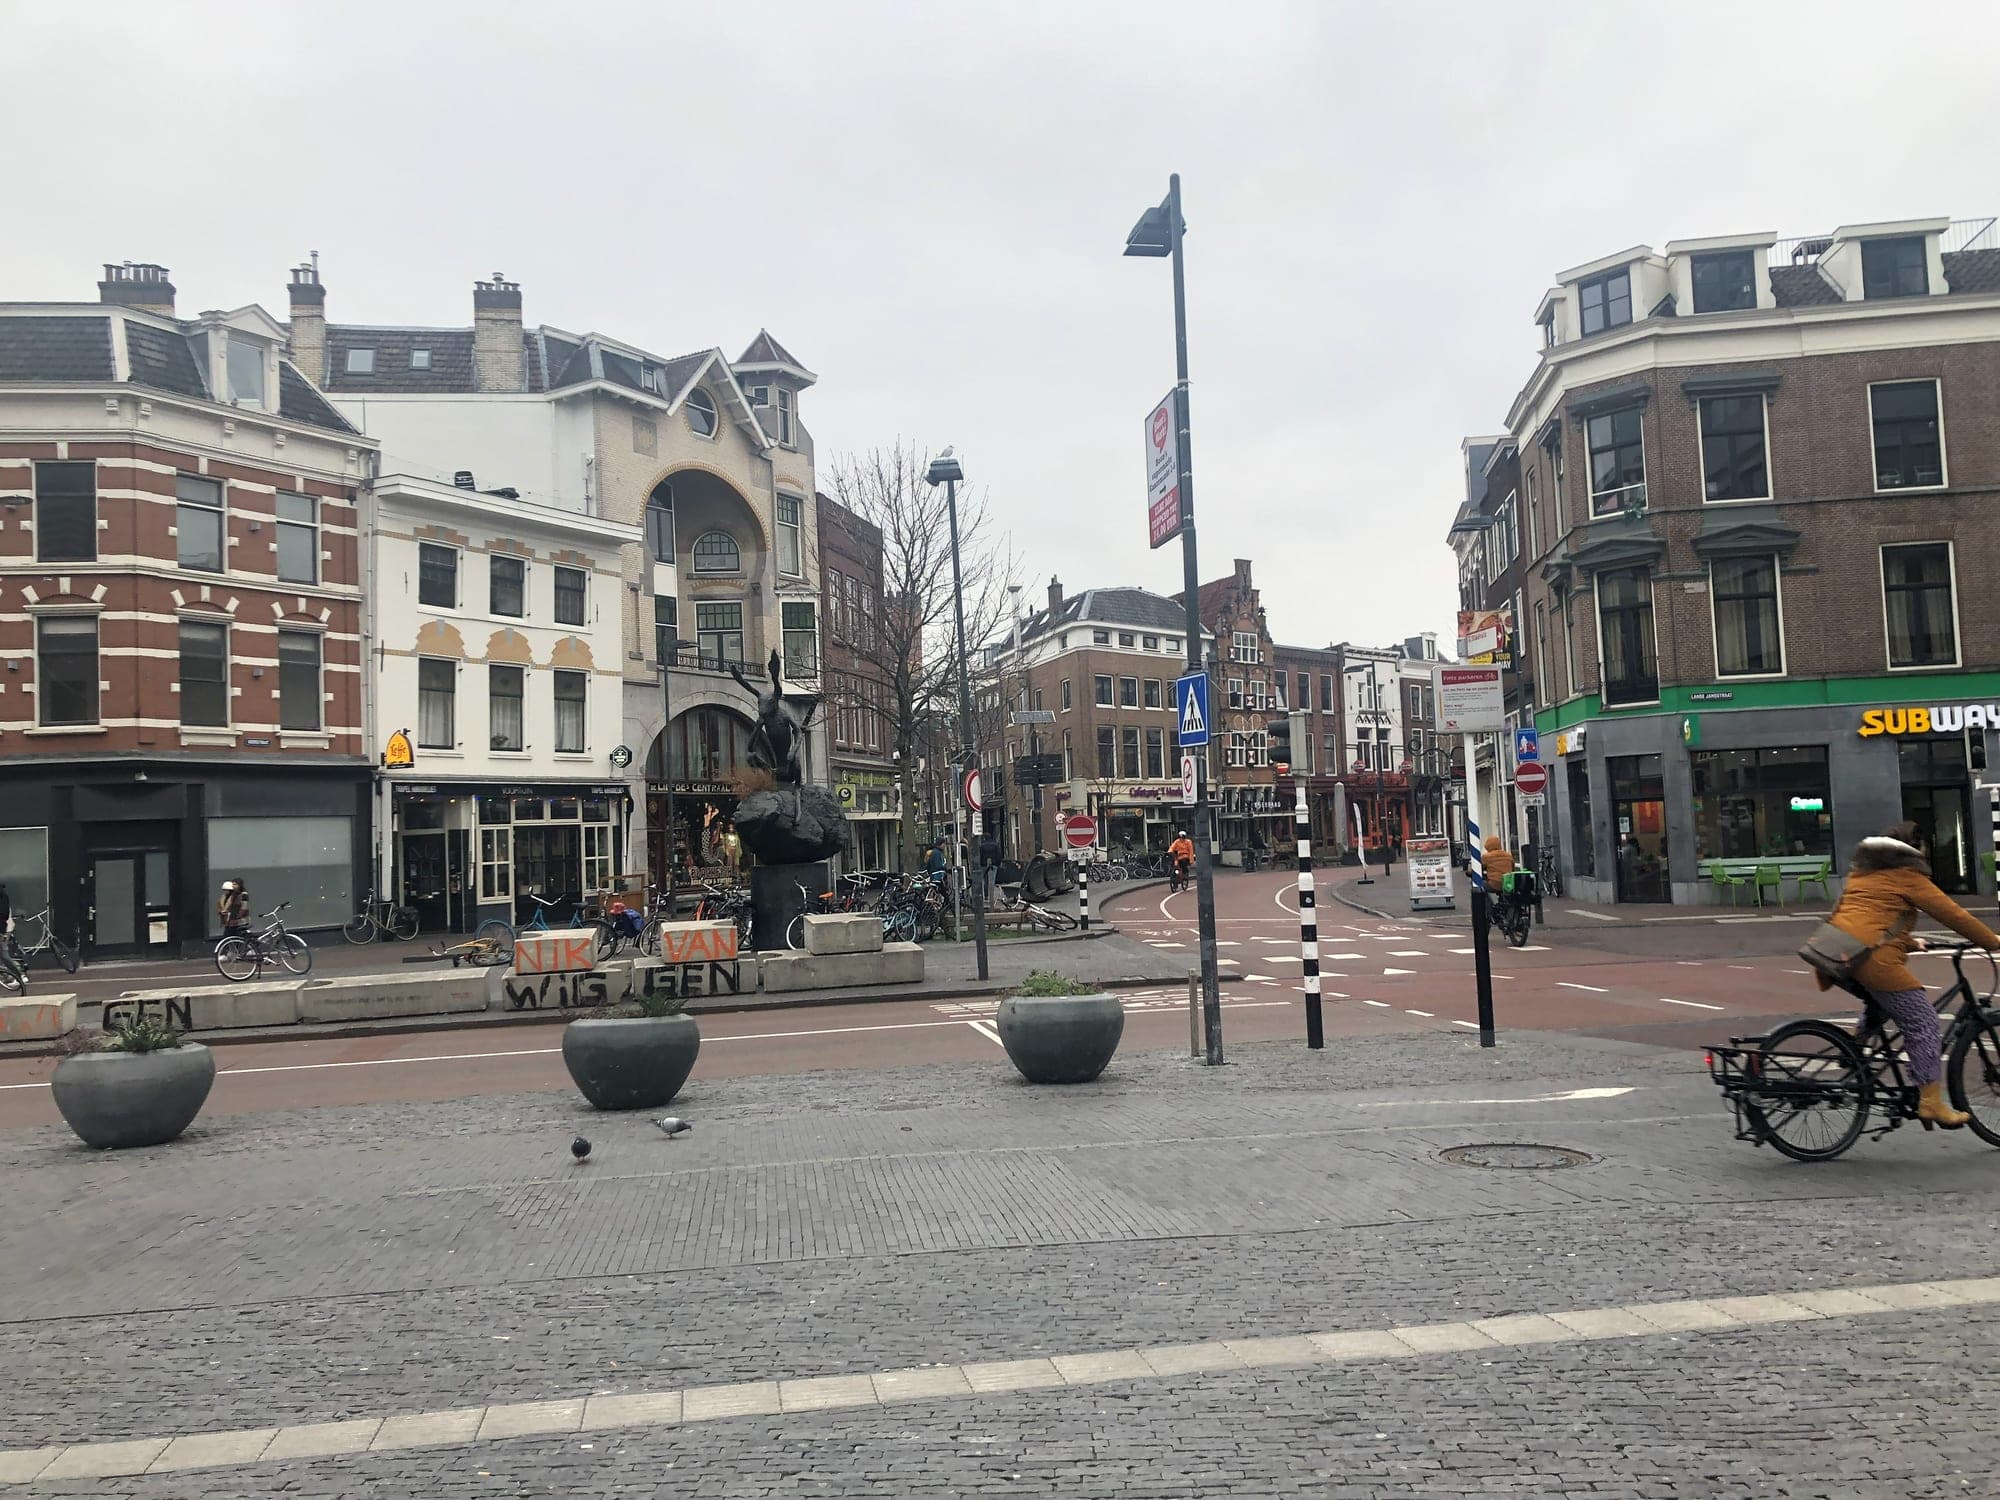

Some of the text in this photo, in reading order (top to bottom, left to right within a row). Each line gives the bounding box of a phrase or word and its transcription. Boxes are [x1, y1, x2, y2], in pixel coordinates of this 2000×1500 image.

[1858, 704, 2000, 737] SUBWAY
[692, 783, 731, 793] CENTRAAL
[664, 928, 737, 963] VAN
